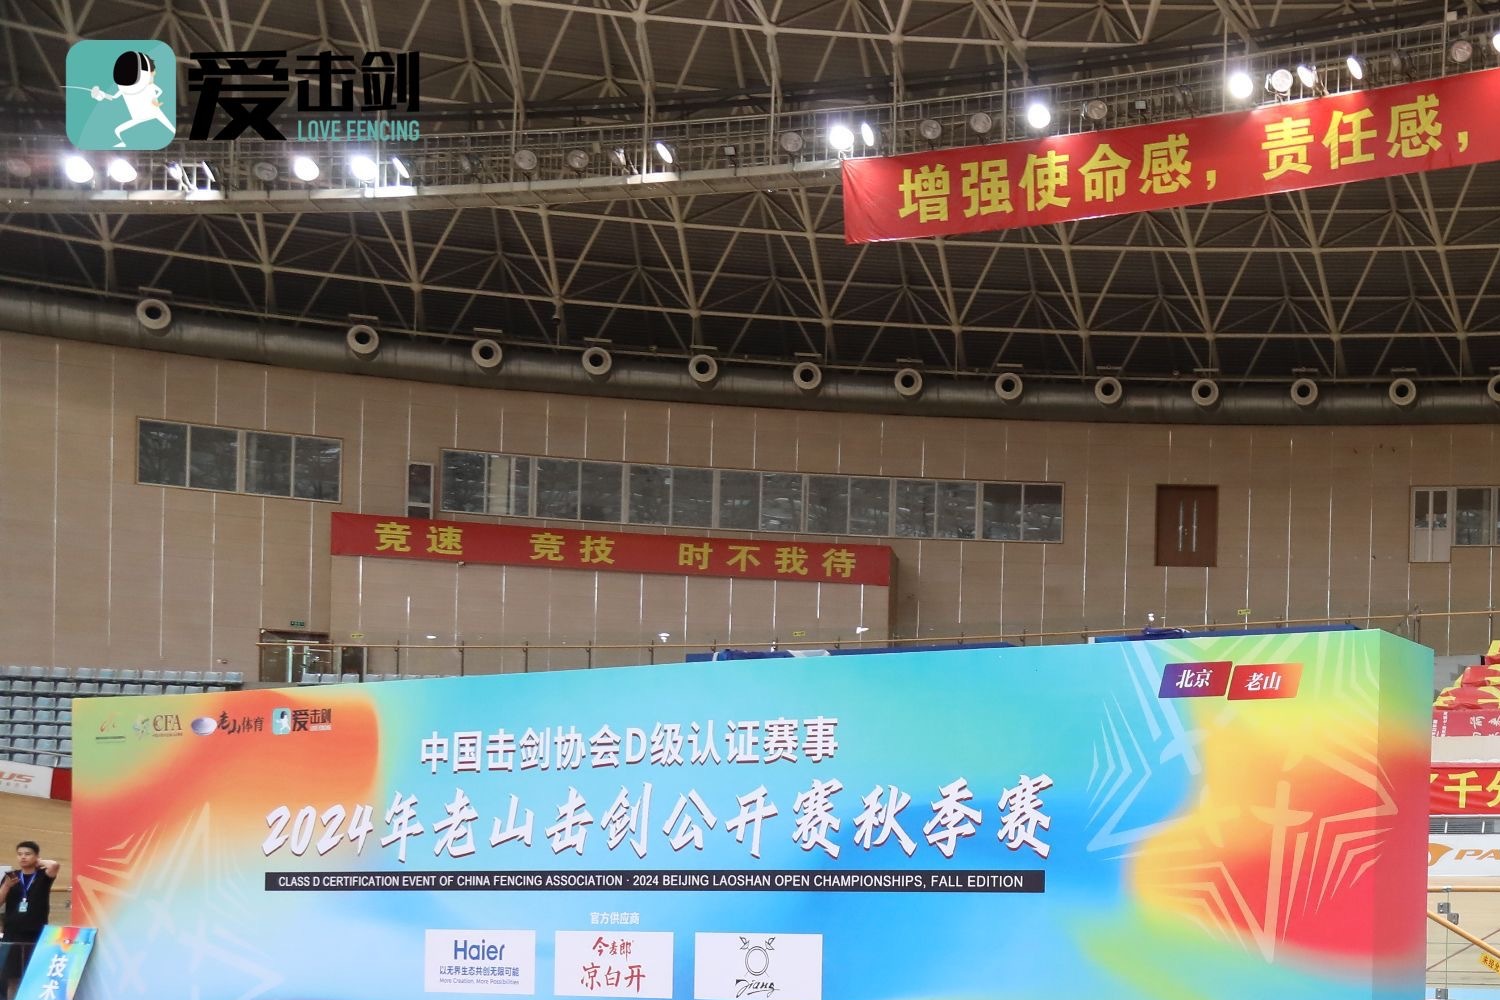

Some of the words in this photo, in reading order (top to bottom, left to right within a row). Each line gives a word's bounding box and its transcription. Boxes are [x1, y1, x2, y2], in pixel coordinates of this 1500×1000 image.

[899, 133, 1217, 223] 增强使命感，
[1261, 95, 1469, 179] 责任感，
[374, 520, 464, 557] 竞速
[530, 531, 615, 566] 竞技
[678, 543, 857, 580] 时不我待
[1175, 669, 1213, 689] 北京
[1244, 671, 1282, 692] 老山
[152, 714, 182, 733] CFA
[217, 710, 265, 735] 老山体育
[420, 715, 839, 775] 中国击剑协会D级认证赛事
[261, 773, 1054, 863] 2024年老山击剑公开赛秋季赛
[278, 875, 310, 887] CLASS
[313, 875, 321, 887] D
[322, 875, 400, 887] CERTIFICATION
[402, 875, 437, 887] EVENT
[439, 875, 454, 887] OF
[456, 875, 490, 887] CHINA
[493, 875, 542, 887] FENCING
[545, 875, 623, 887] ASSOCIATION
[632, 875, 660, 887] 2024
[662, 875, 709, 887] BEIJING
[712, 875, 771, 887] LAOSHAN
[774, 875, 810, 887] OPEN
[813, 875, 927, 889] CHAMPIONSHIPS,
[931, 875, 963, 887] FALL
[967, 875, 1024, 887] EDITION
[590, 911, 640, 925] 官方供应商
[453, 939, 505, 961] Haier
[592, 936, 634, 957] 今麦郎
[439, 964, 520, 977] 以无界生态共创无限可能
